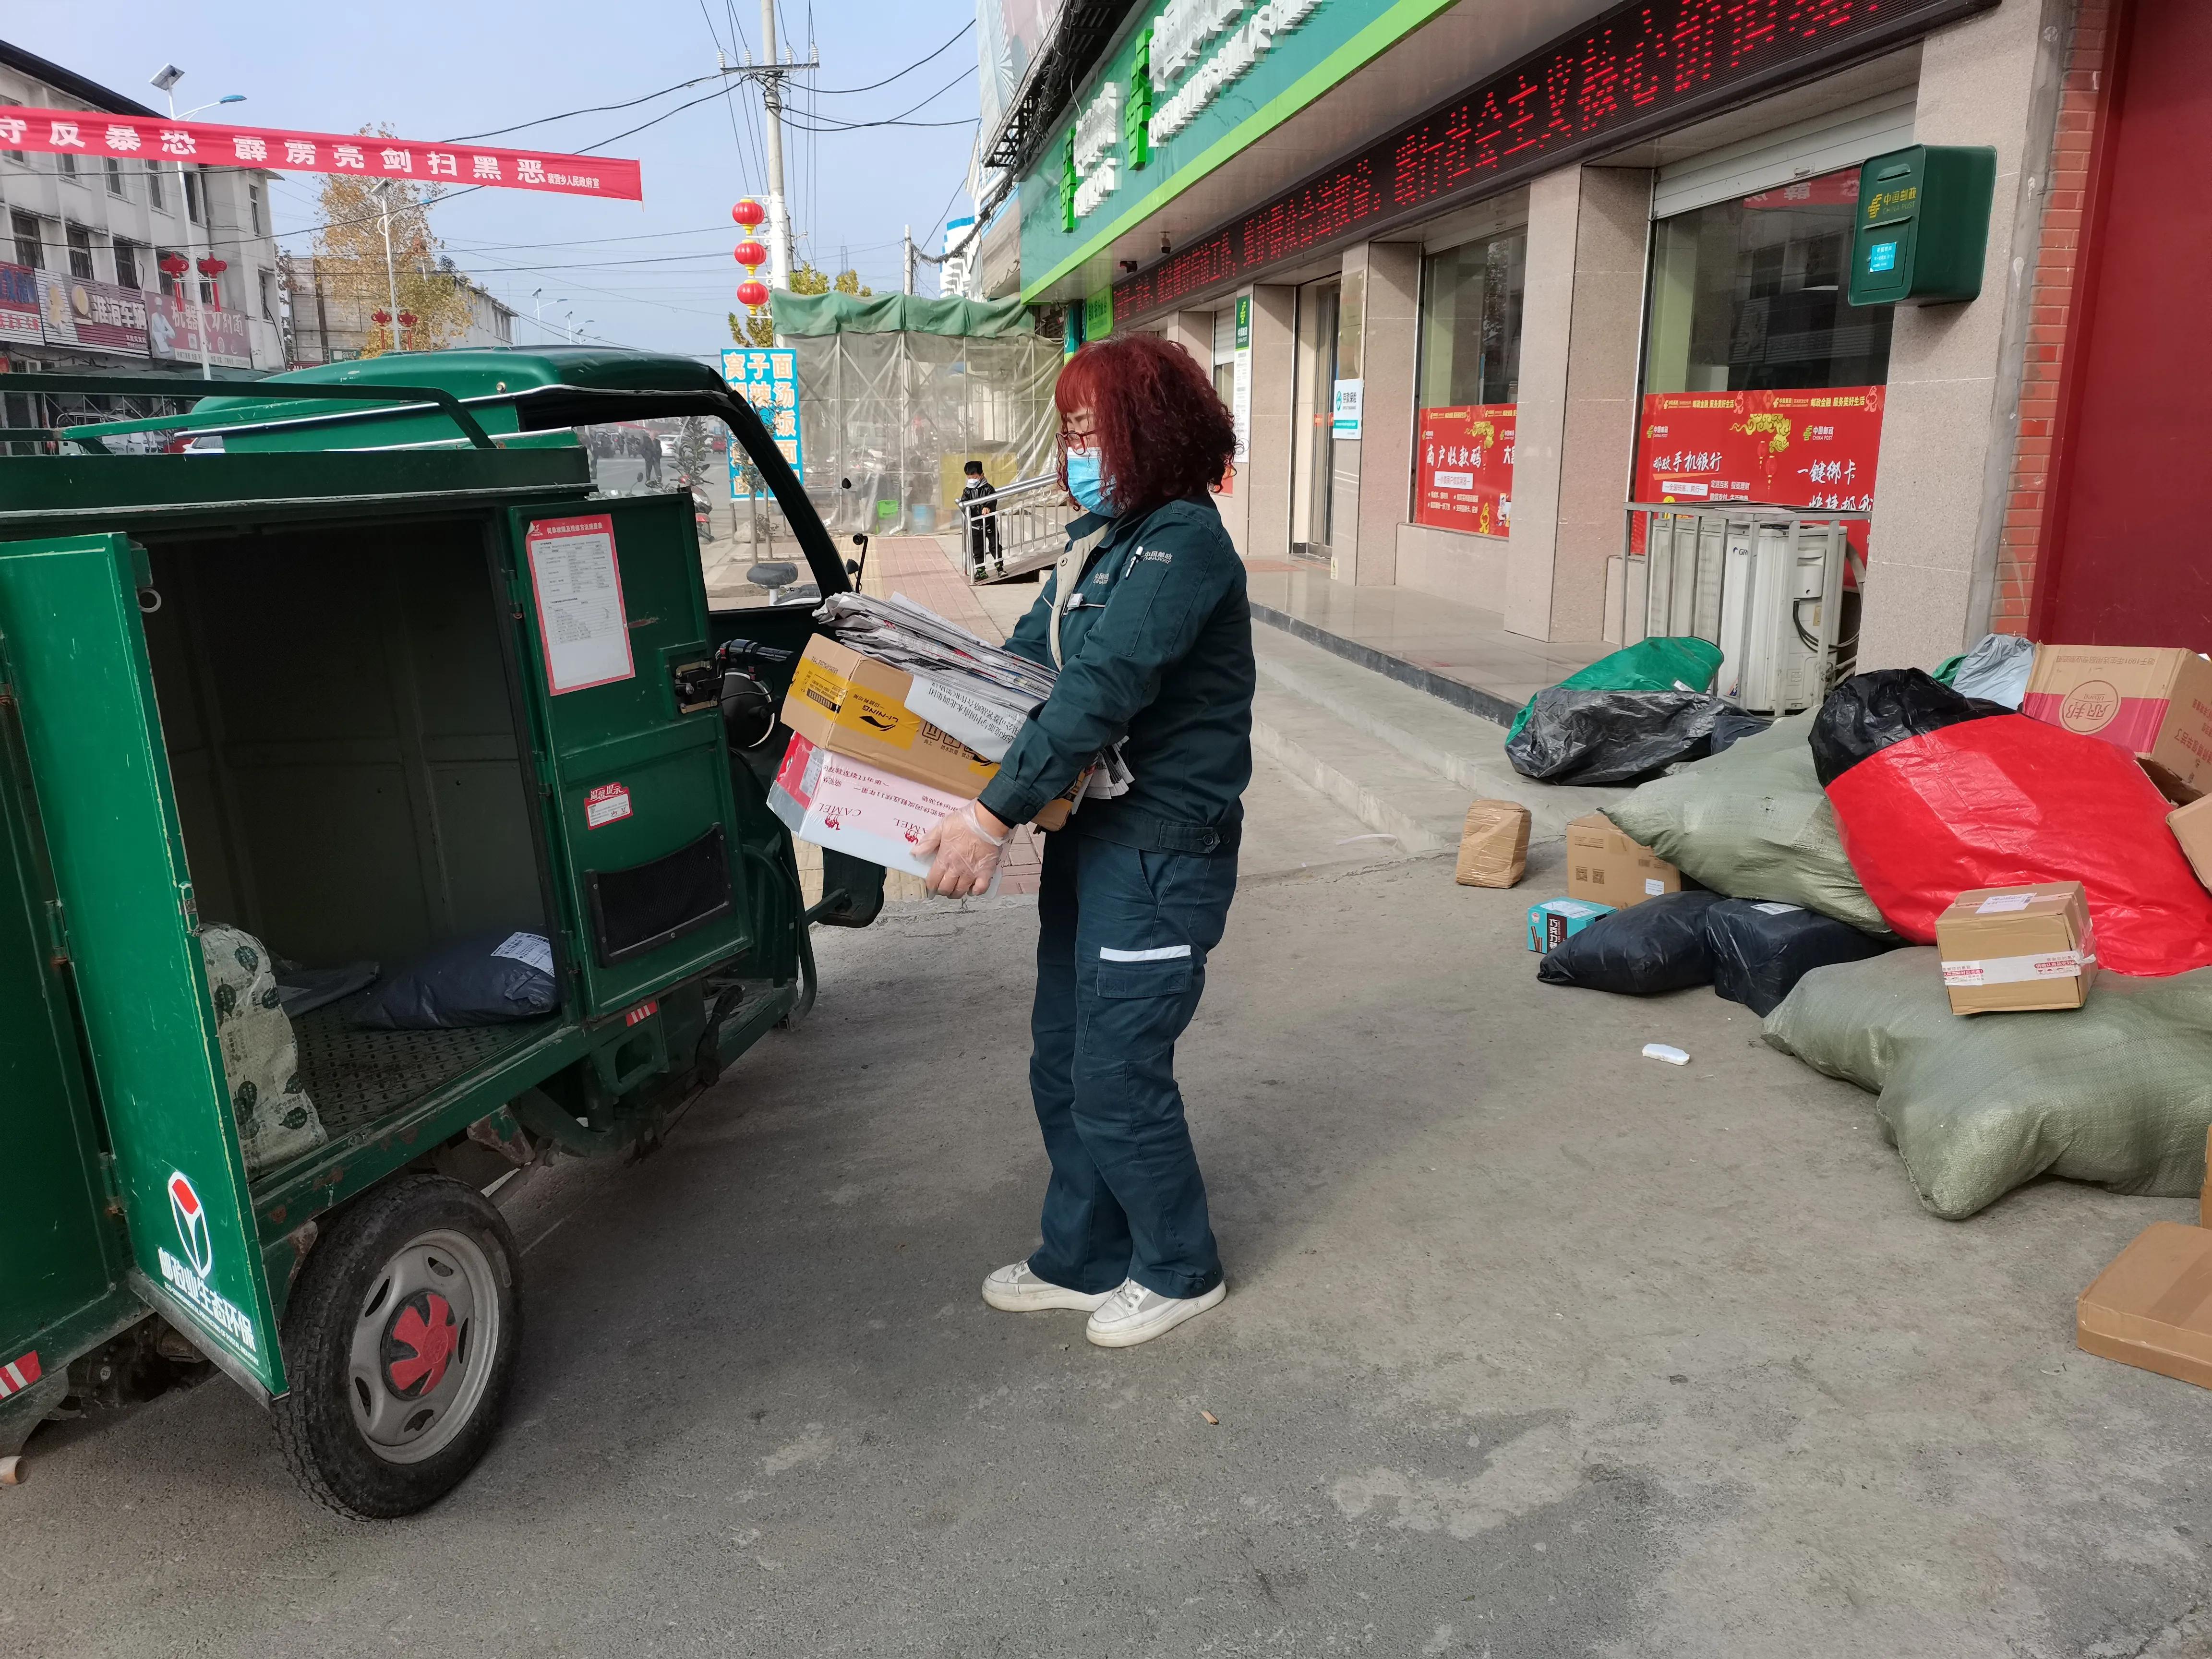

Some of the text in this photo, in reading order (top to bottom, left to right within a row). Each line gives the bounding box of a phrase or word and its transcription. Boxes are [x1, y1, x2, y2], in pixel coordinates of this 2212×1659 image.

[1884, 186, 1917, 205] 中国邮政
[1883, 201, 1915, 215] CHNA POST
[723, 351, 793, 380] 窝子面
[1833, 396, 1865, 407] 服务美好生活
[1813, 426, 1834, 434] 中国邮政
[1427, 444, 1482, 469] 商户收款码
[1653, 451, 1723, 472] 邮政手机银行
[1797, 459, 1856, 485] 一键绑卡
[862, 704, 899, 723] LI-NING
[928, 687, 1015, 745] 态环境部与中国南水北调集团
[2065, 702, 2111, 721] 丽邦
[590, 783, 624, 800] 温馨提示
[817, 802, 862, 817] CAMEL
[158, 1246, 256, 1352] 邮政业生态环保
